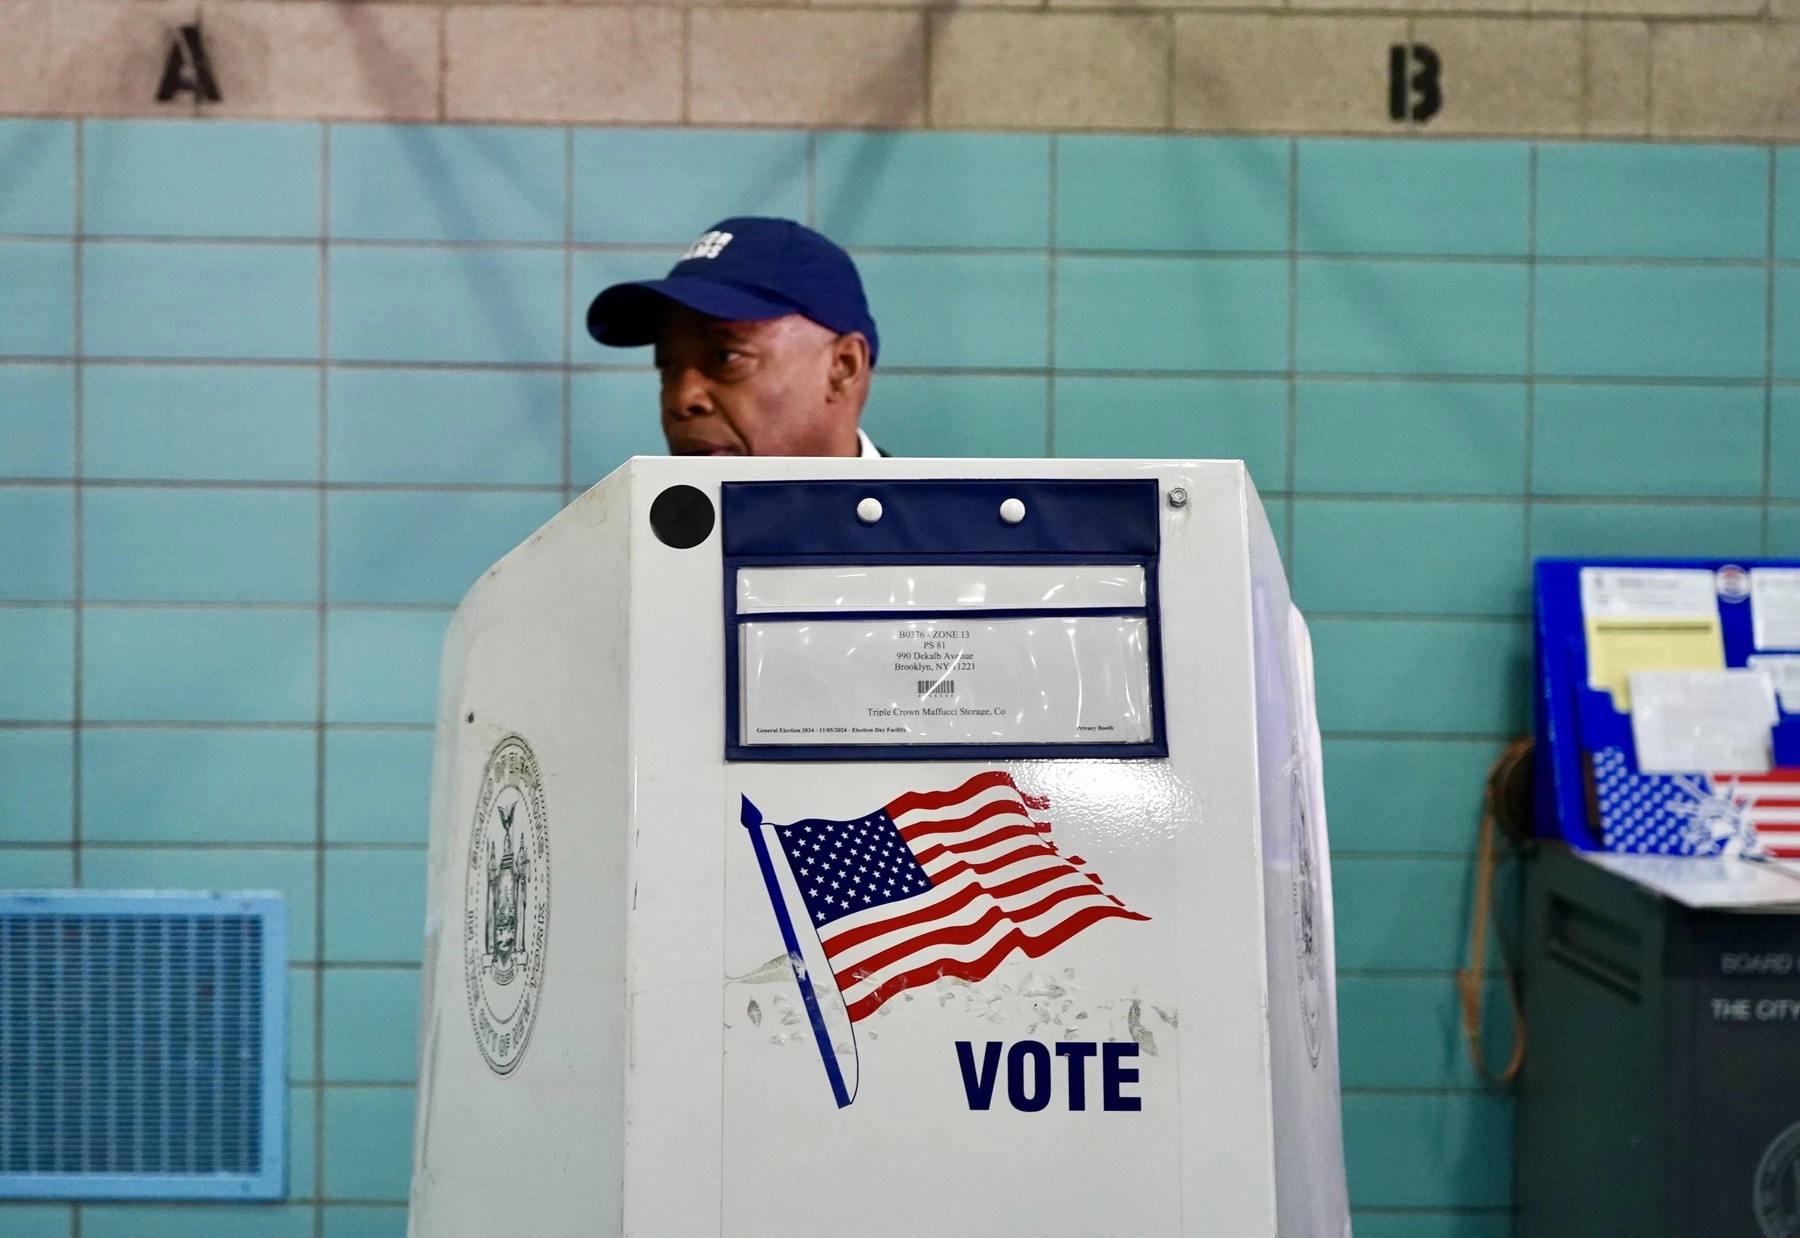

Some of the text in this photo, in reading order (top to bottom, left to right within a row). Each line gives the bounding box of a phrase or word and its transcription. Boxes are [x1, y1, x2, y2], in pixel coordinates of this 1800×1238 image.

[155, 25, 222, 103] A
[1390, 42, 1442, 123] B
[899, 631, 925, 639] B0376
[932, 631, 958, 639] ZONE
[961, 631, 970, 639] 13
[923, 641, 946, 649] PS 81
[896, 652, 912, 660] 990
[914, 652, 942, 660] Dekalb
[894, 663, 934, 672] Brooklyn,
[935, 663, 950, 671] NY
[867, 708, 891, 717] Triple
[893, 708, 920, 716] Crown
[922, 707, 957, 716] Maffucci
[994, 707, 1006, 716] Co
[1721, 953, 1794, 975] BOARD
[1711, 999, 1751, 1021] THE
[955, 1040, 1142, 1112] VOTE
